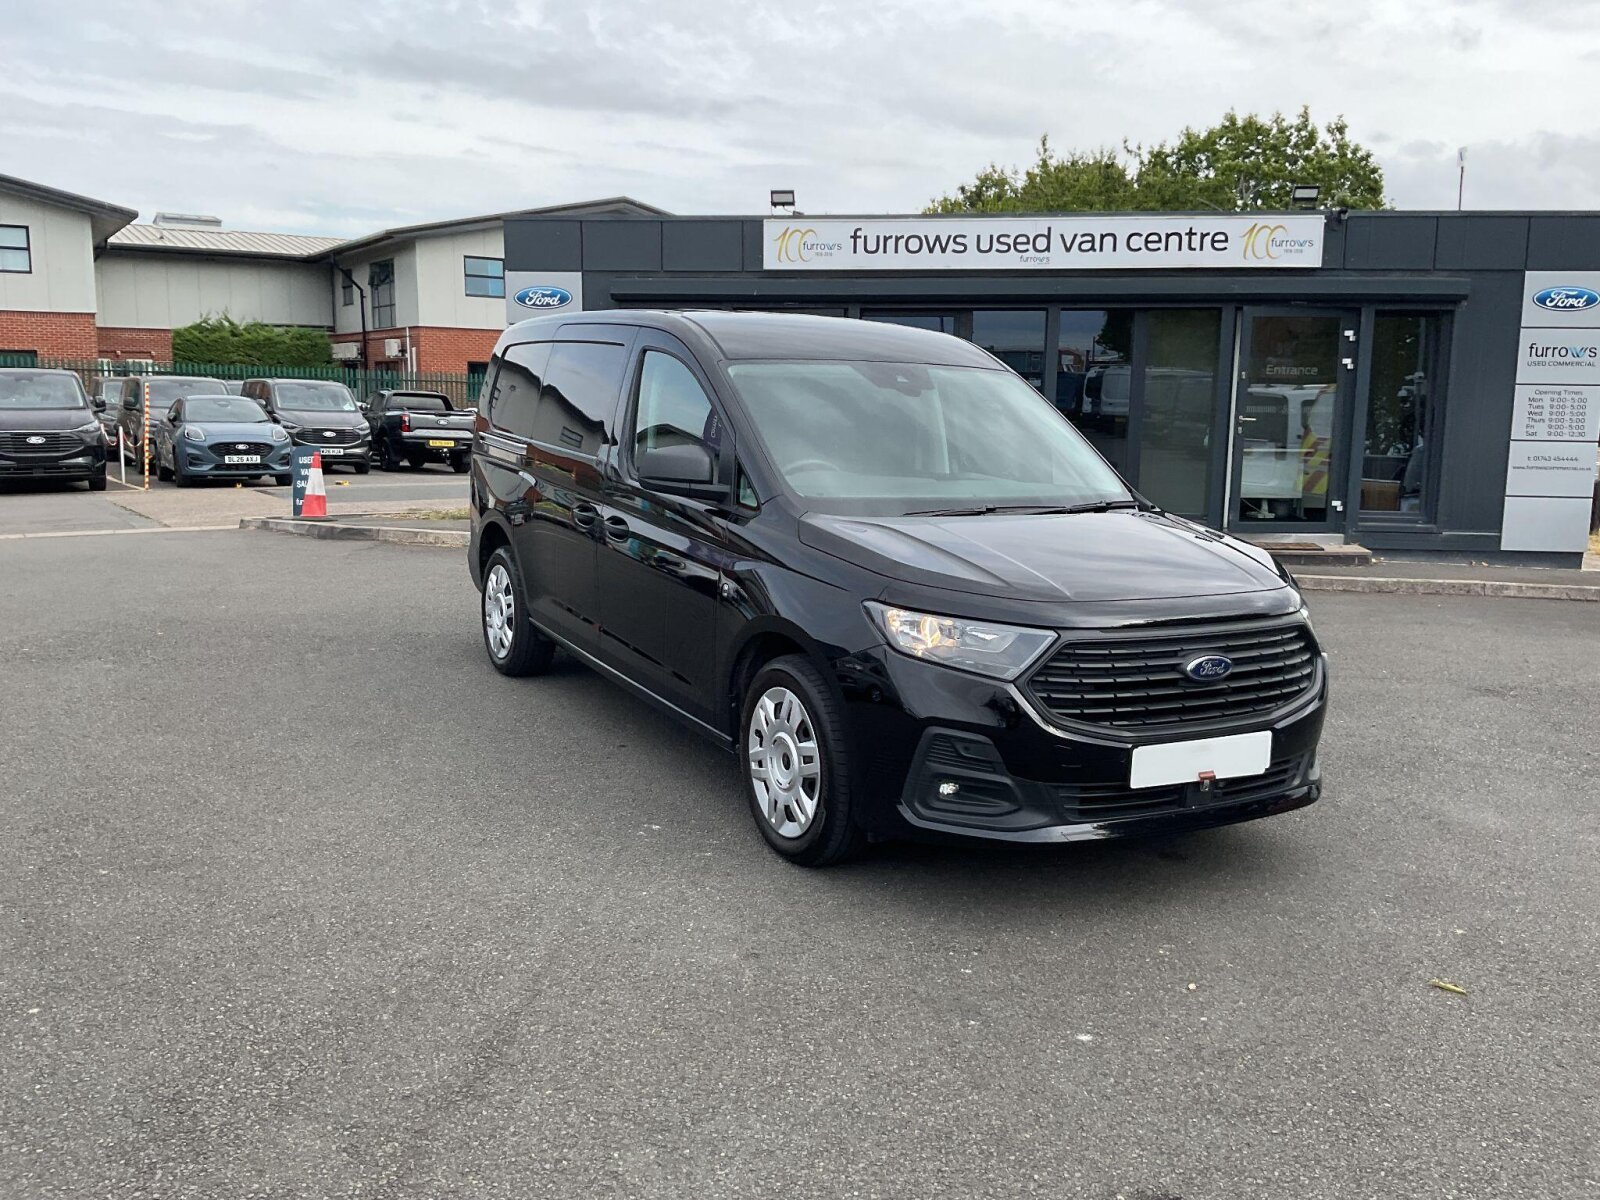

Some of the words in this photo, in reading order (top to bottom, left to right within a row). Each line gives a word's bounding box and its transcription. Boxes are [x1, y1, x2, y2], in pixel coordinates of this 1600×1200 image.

[803, 240, 843, 251] furrows
[850, 228, 968, 254] furrows
[976, 227, 1052, 254] used
[1059, 232, 1118, 253] van
[1126, 226, 1229, 252] centre
[1271, 237, 1315, 248] furrows
[526, 290, 561, 305] Ford
[1546, 289, 1588, 307] Ford
[1529, 343, 1598, 358] furrows
[1266, 364, 1319, 376] Entrance
[1548, 360, 1597, 368] COMMERCIAL
[1200, 660, 1225, 675] Ford
